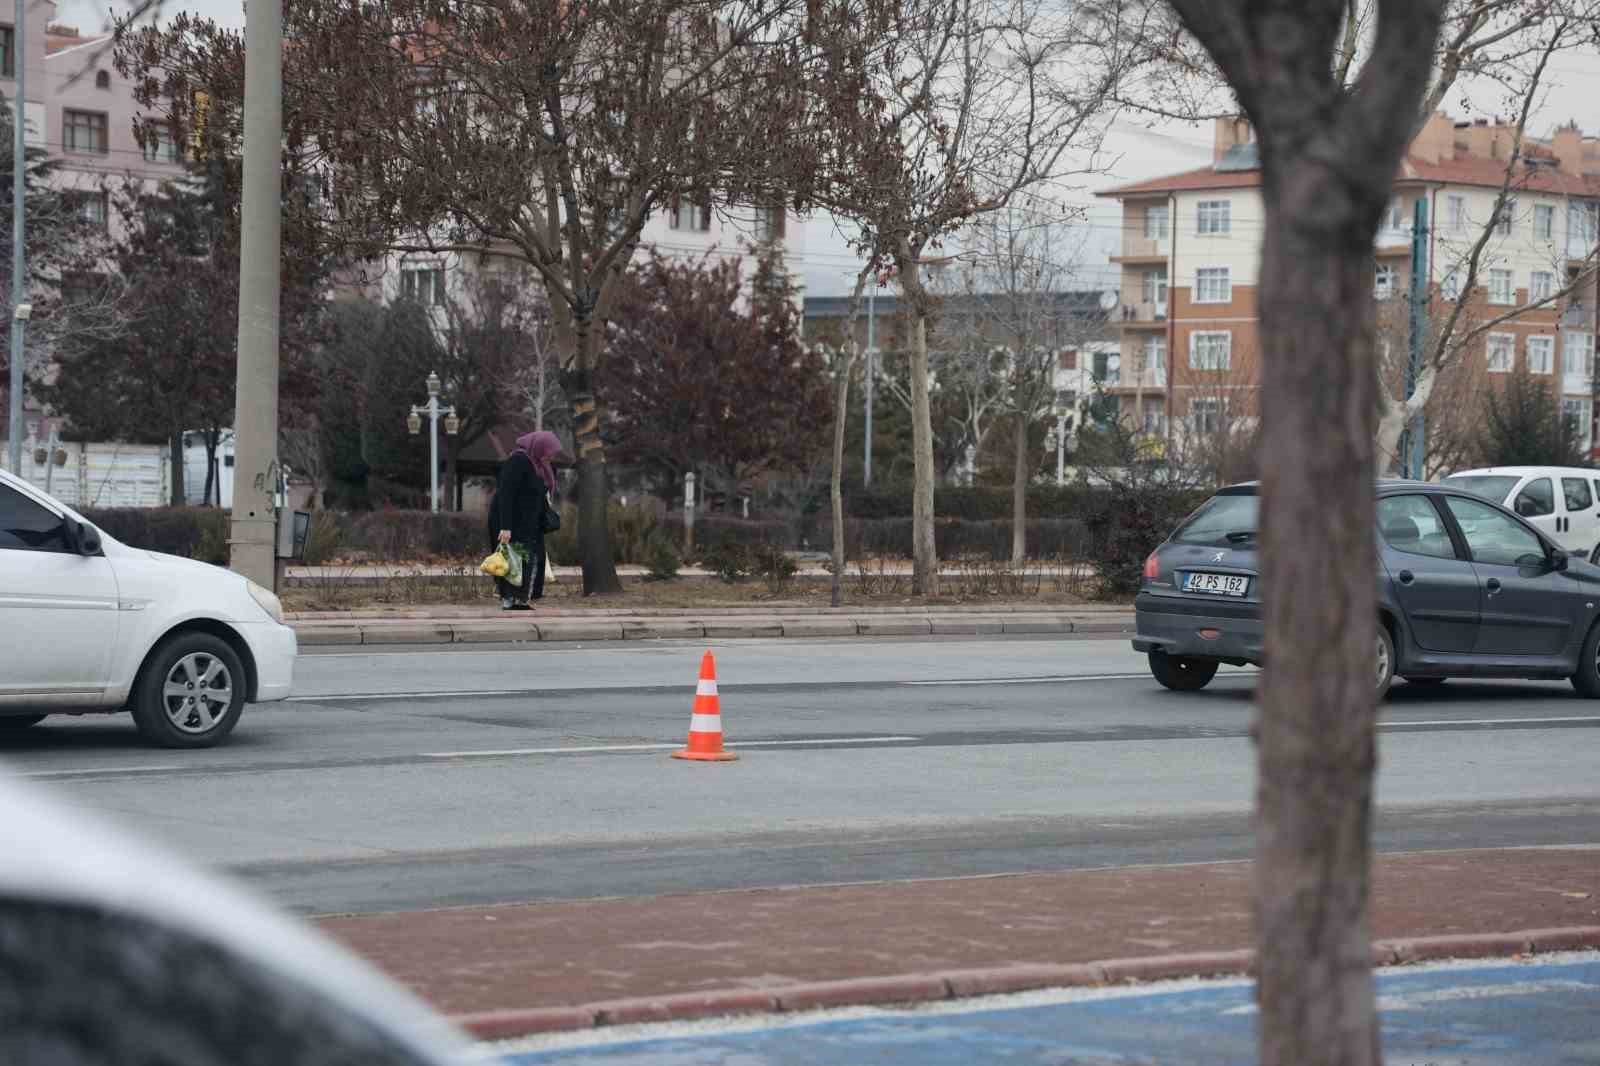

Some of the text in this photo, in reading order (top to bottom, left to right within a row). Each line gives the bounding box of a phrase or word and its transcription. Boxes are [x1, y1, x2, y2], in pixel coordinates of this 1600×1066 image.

[1190, 575, 1242, 591] 42 PS 162
